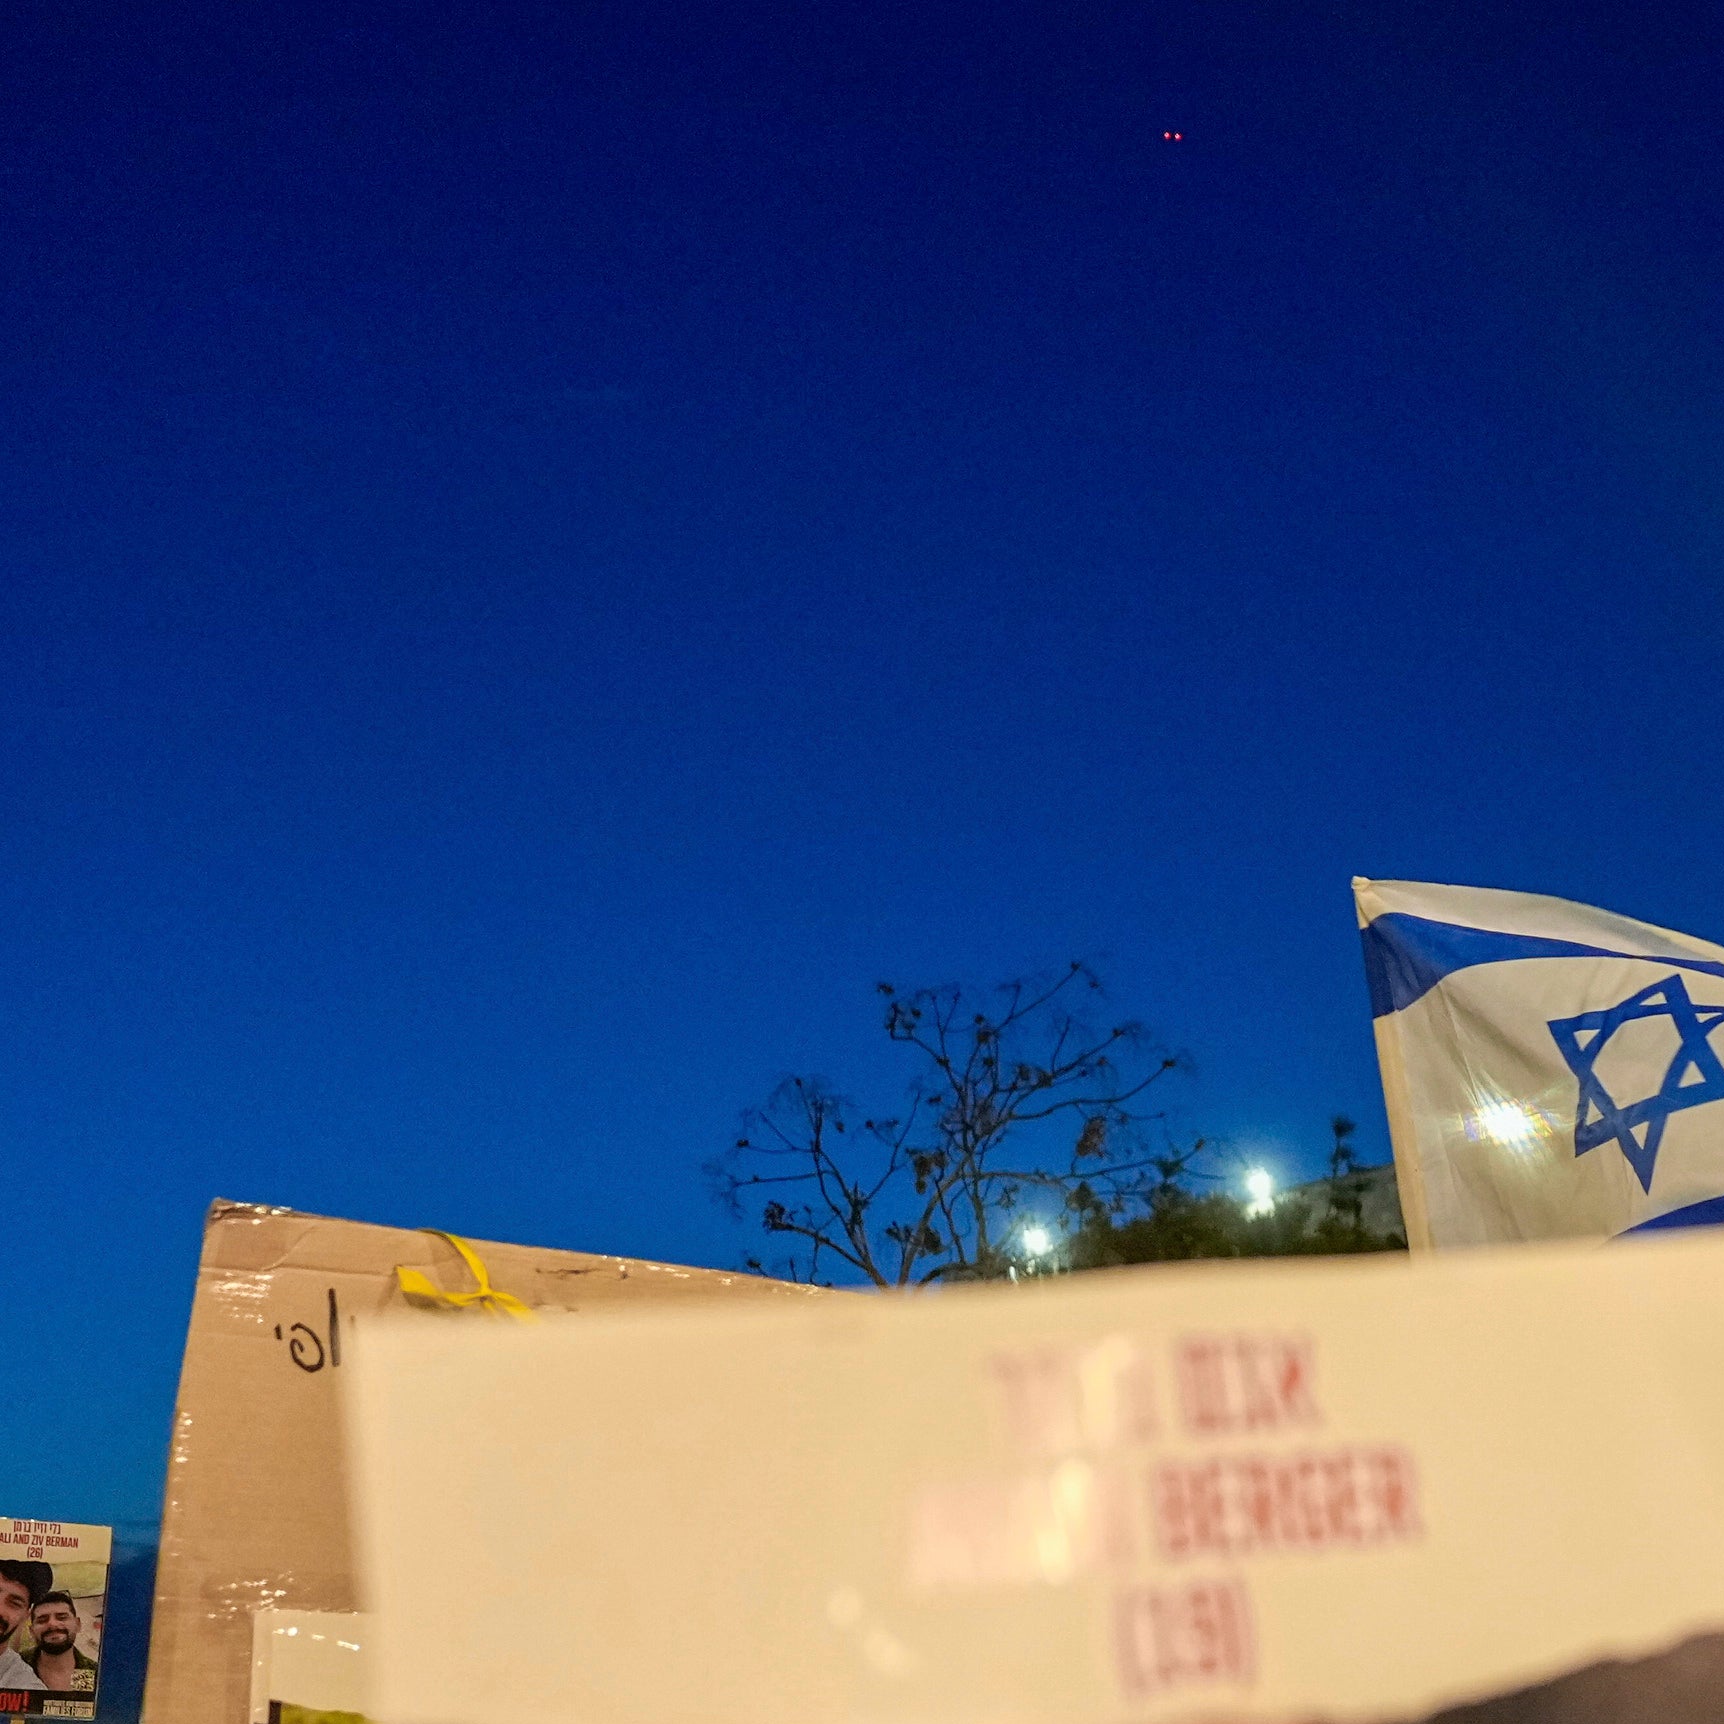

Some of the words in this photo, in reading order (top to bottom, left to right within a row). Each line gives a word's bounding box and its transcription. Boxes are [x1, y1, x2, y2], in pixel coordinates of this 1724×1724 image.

[0, 1532, 12, 1543] ALI
[13, 1534, 30, 1545] AND
[31, 1535, 45, 1546] ZIV
[45, 1536, 79, 1549] BERMAN
[27, 1547, 43, 1559] (26)
[0, 1690, 30, 1712] OW!
